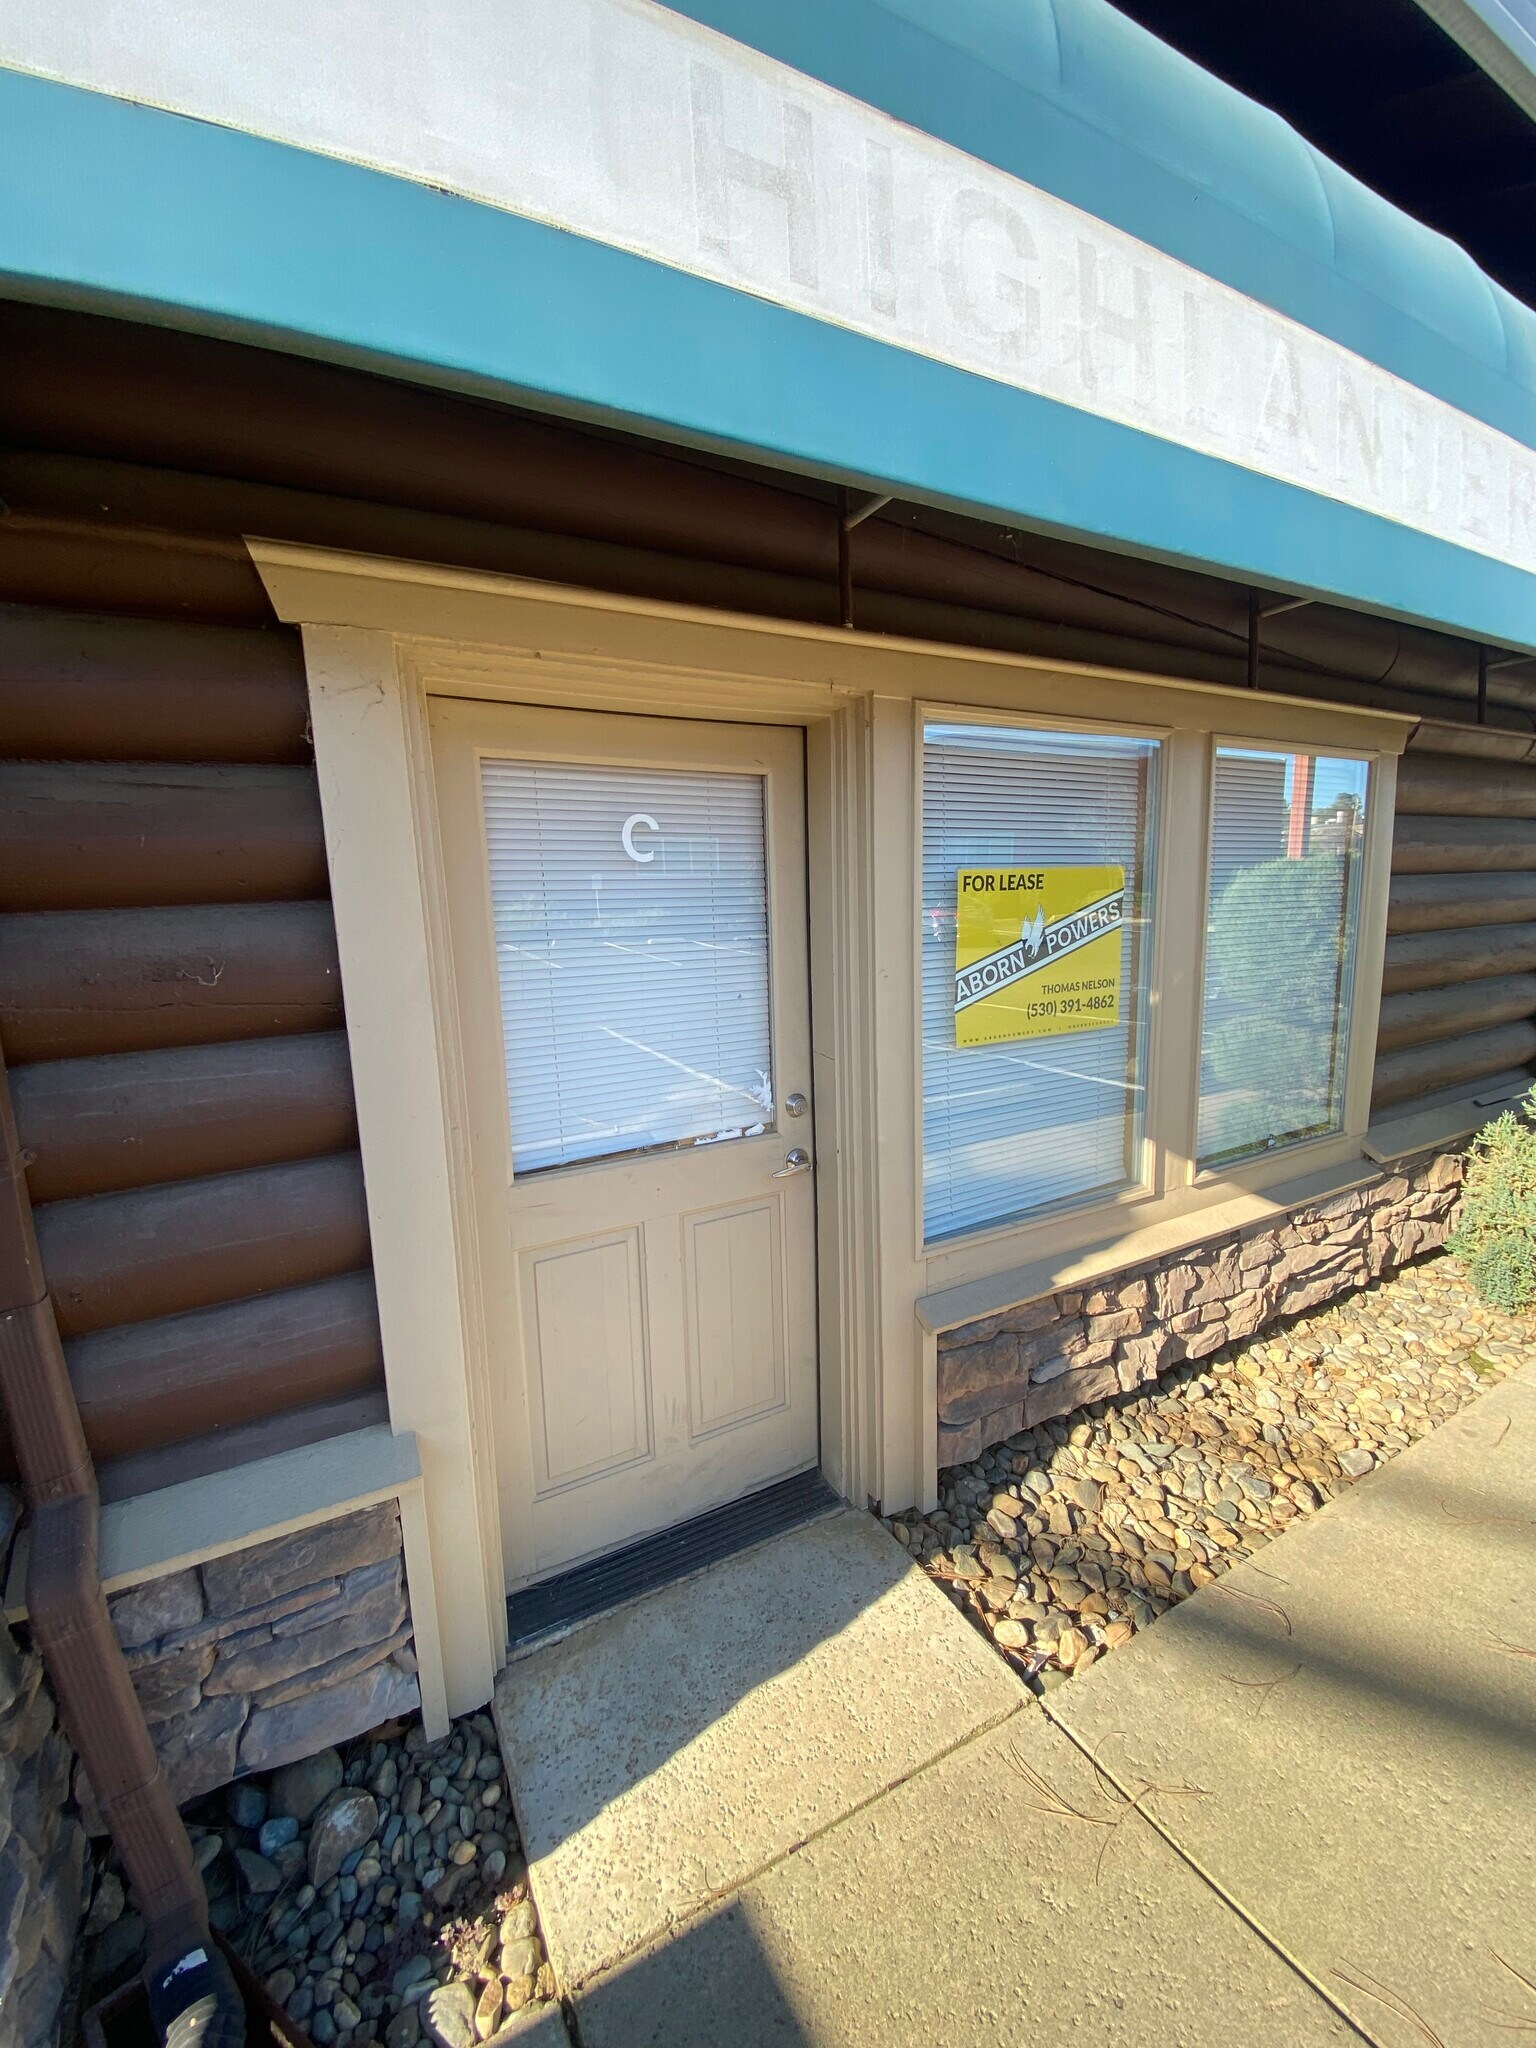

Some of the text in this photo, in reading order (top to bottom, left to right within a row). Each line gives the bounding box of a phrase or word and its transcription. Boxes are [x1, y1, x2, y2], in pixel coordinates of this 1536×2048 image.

[622, 813, 660, 862] C
[963, 873, 1044, 892] FOR LEASE
[957, 902, 1120, 1001] ABORN POWERS
[1042, 978, 1115, 995] THOMAS NELSON
[1027, 994, 1114, 1020] (530) 391-4862
